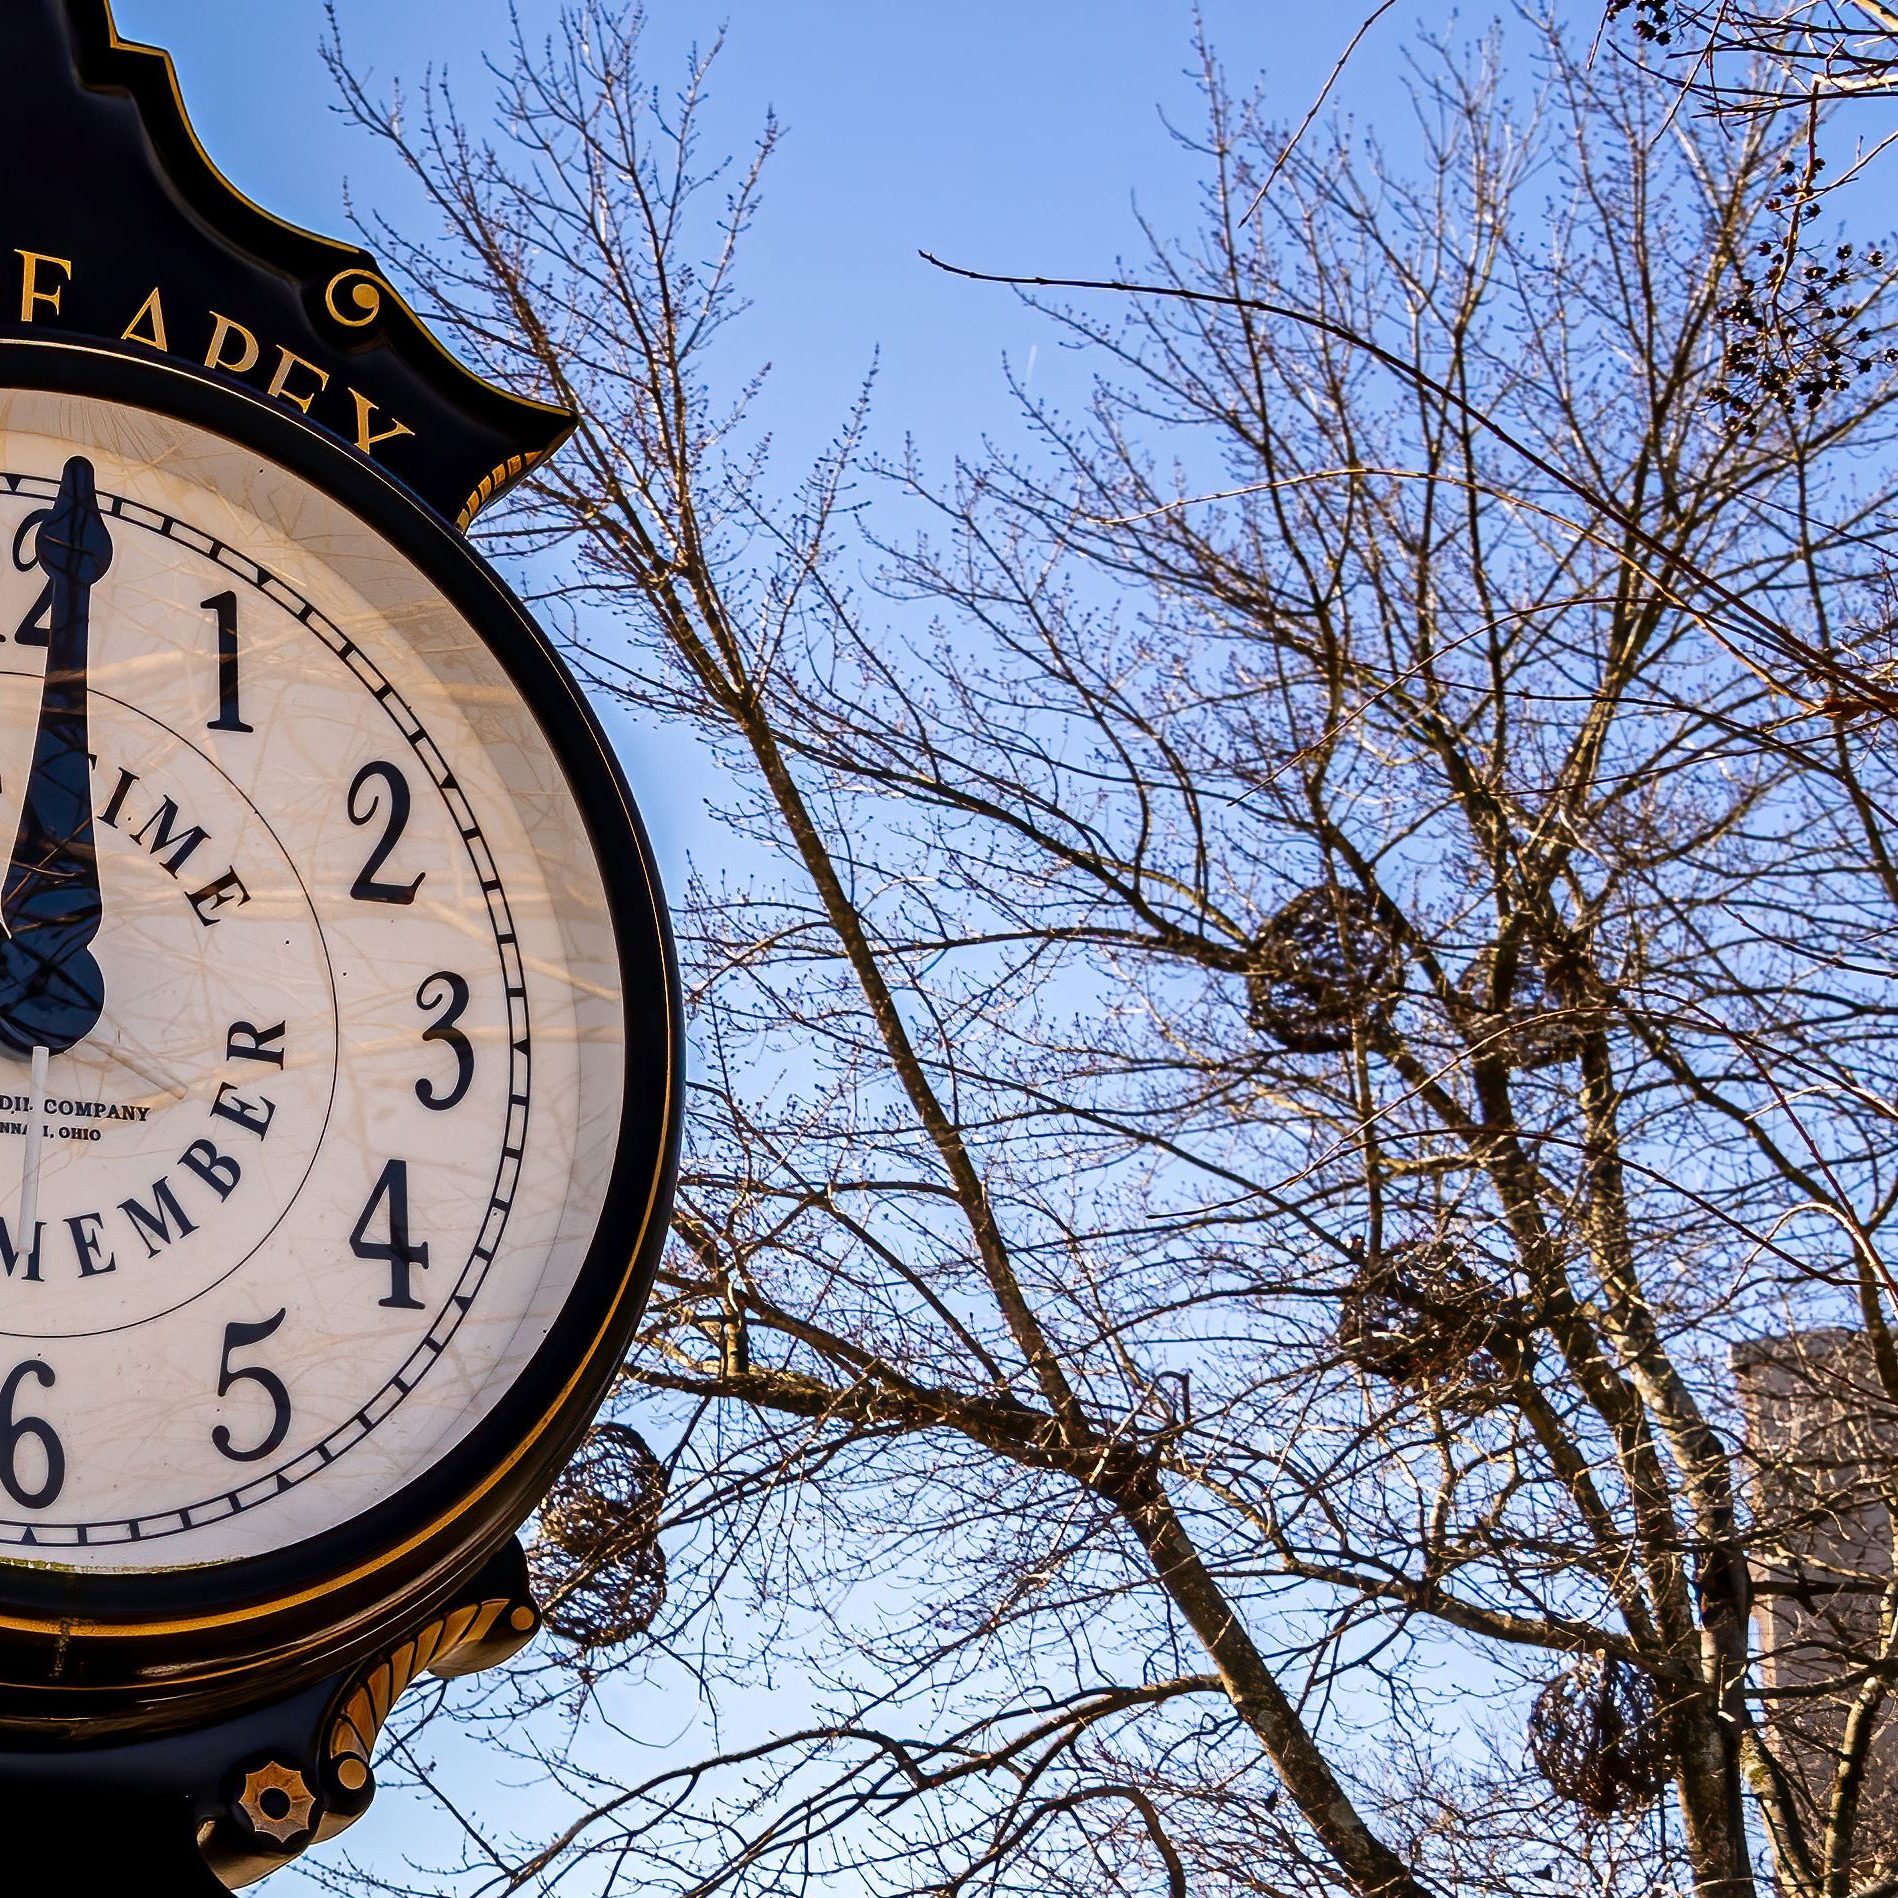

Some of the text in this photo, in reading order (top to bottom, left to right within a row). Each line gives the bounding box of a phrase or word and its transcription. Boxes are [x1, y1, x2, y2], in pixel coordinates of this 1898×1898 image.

[200, 591, 253, 734] 1
[87, 751, 252, 928] IME
[346, 760, 427, 905] 2
[43, 1097, 151, 1122] COMPANY
[415, 970, 476, 1112] 3
[58, 1126, 102, 1142] OHIO
[349, 1158, 430, 1311] 4
[211, 1306, 293, 1462] 5
